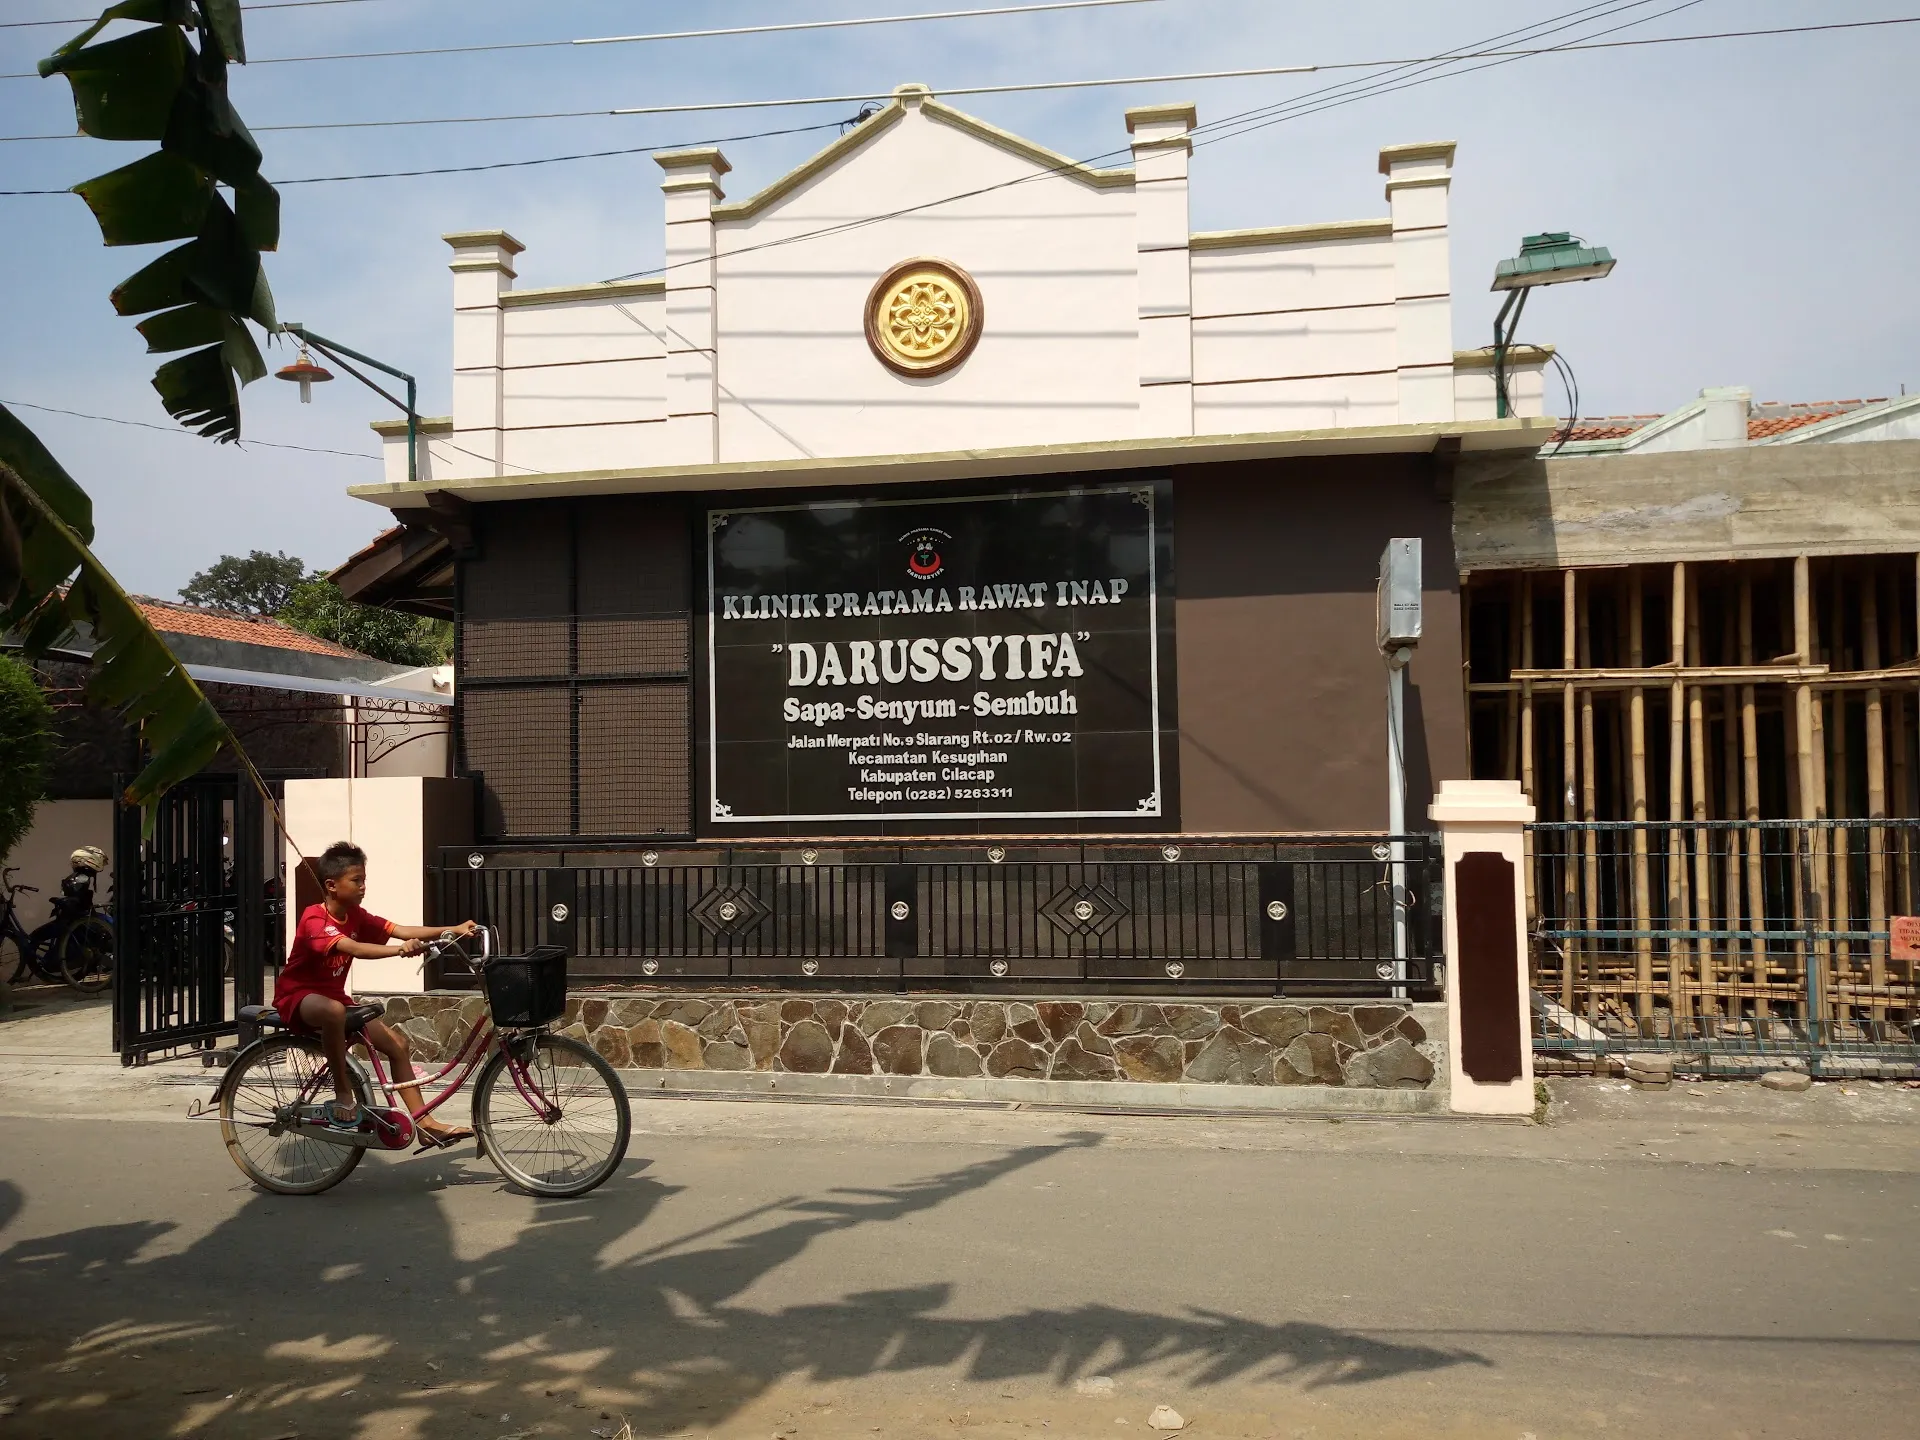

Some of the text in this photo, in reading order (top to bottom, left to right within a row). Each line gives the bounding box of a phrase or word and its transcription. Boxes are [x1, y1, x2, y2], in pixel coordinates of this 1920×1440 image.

[723, 579, 1128, 619] KLINIK PRATAMA RAWAT INAP
[788, 735, 825, 748] Jalan
[827, 734, 880, 750] Merpati
[849, 750, 1007, 766] Kecamatan Kesugihan
[861, 768, 994, 785] Kabupaten Cilacap
[848, 787, 1012, 803] Telepon (0282) 5263311
